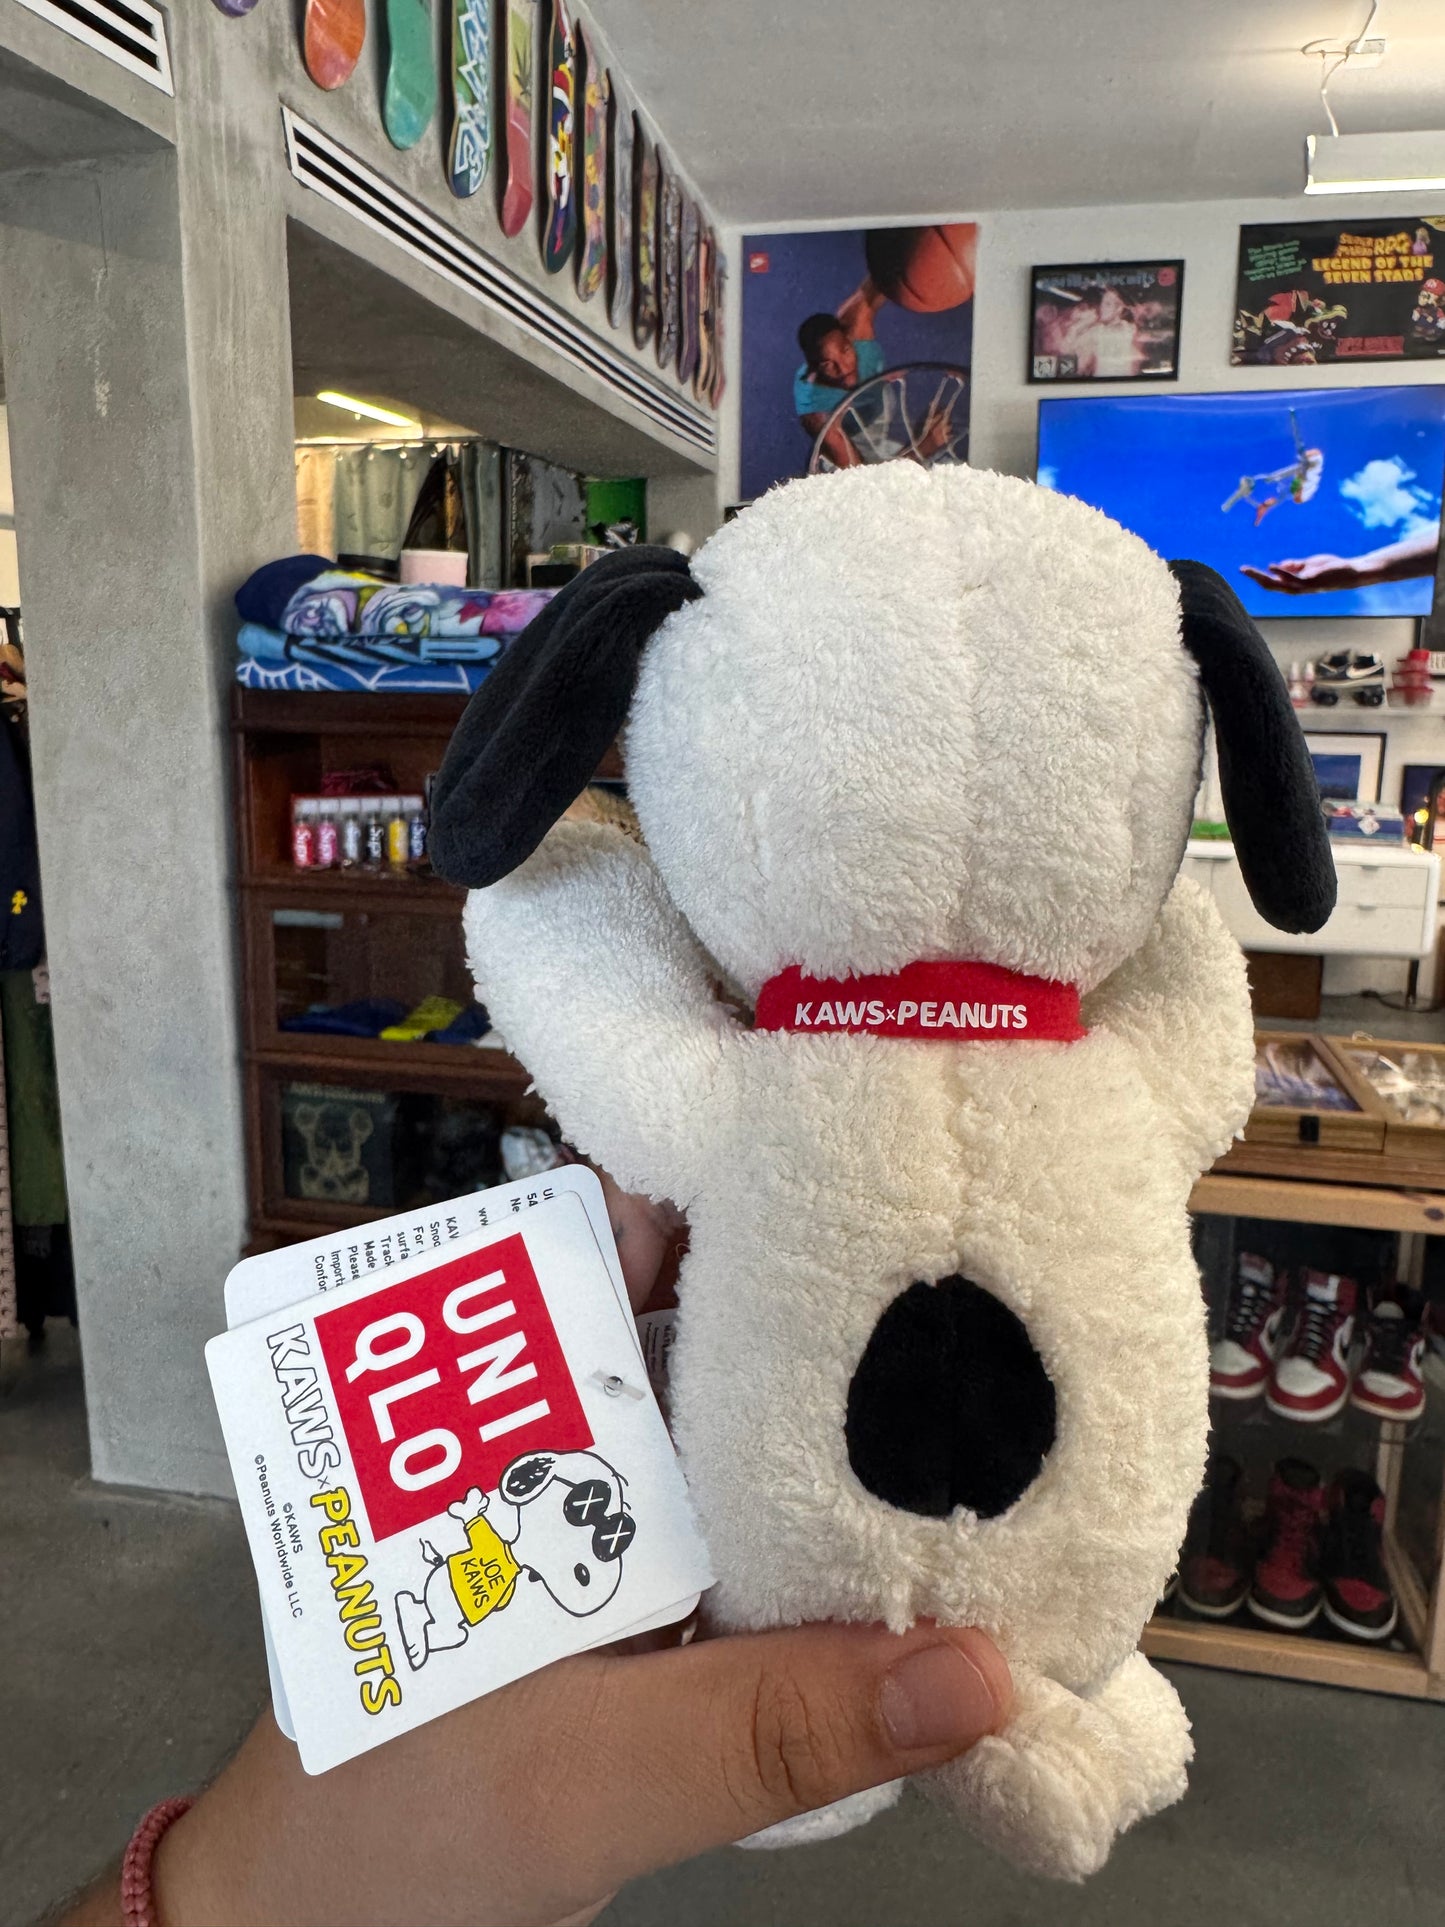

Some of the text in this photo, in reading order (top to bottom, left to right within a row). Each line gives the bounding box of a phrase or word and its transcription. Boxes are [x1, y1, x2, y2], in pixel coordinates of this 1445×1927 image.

[1311, 255, 1434, 272] LEGEND OF THE
[1323, 268, 1424, 284] SEVEN STARS
[396, 1231, 409, 1260] surfa
[413, 1226, 424, 1247] For
[347, 1245, 360, 1281] Please
[364, 1240, 376, 1269] Made
[442, 1269, 551, 1443] UNI
[345, 1311, 462, 1492] QLO
[270, 1517, 294, 1589] Worldwide
[288, 1591, 303, 1619] LLC
[460, 1557, 490, 1609] KAWS
[479, 1557, 506, 1590] JOE
